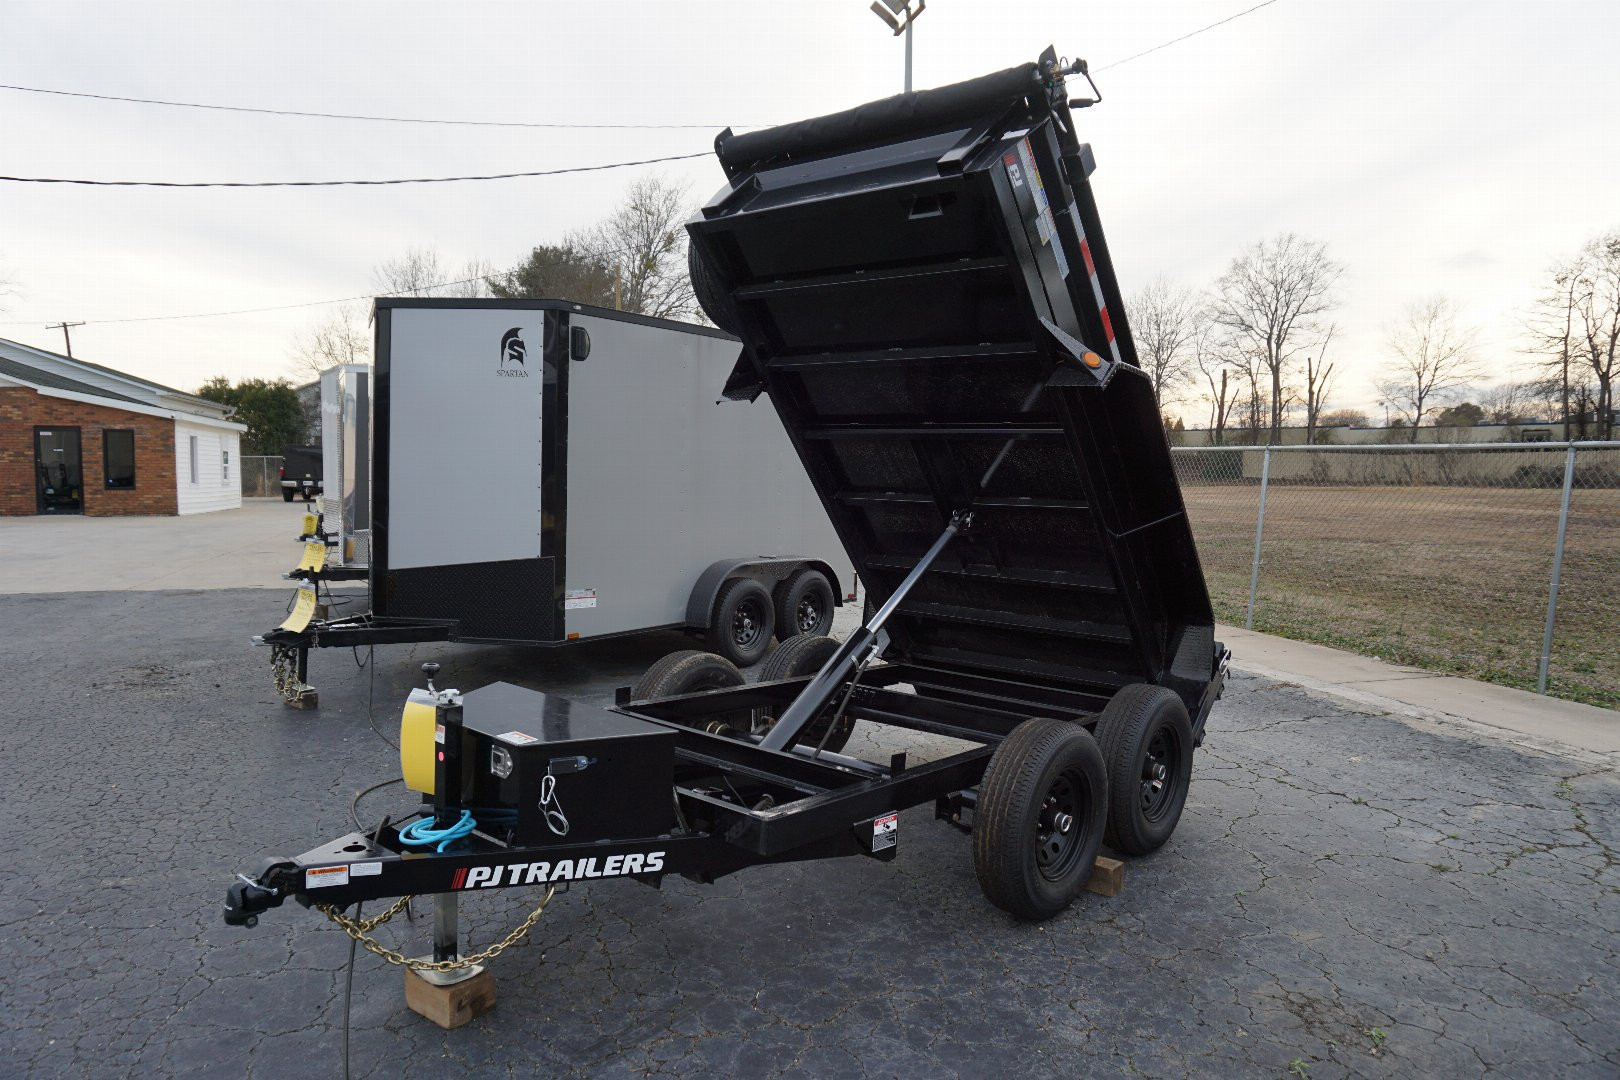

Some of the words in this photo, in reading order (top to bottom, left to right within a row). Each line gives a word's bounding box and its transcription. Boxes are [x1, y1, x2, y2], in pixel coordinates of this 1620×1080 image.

[496, 369, 530, 378] SPARTAN
[464, 865, 504, 889] PJ
[508, 851, 666, 885] TRAILERS
